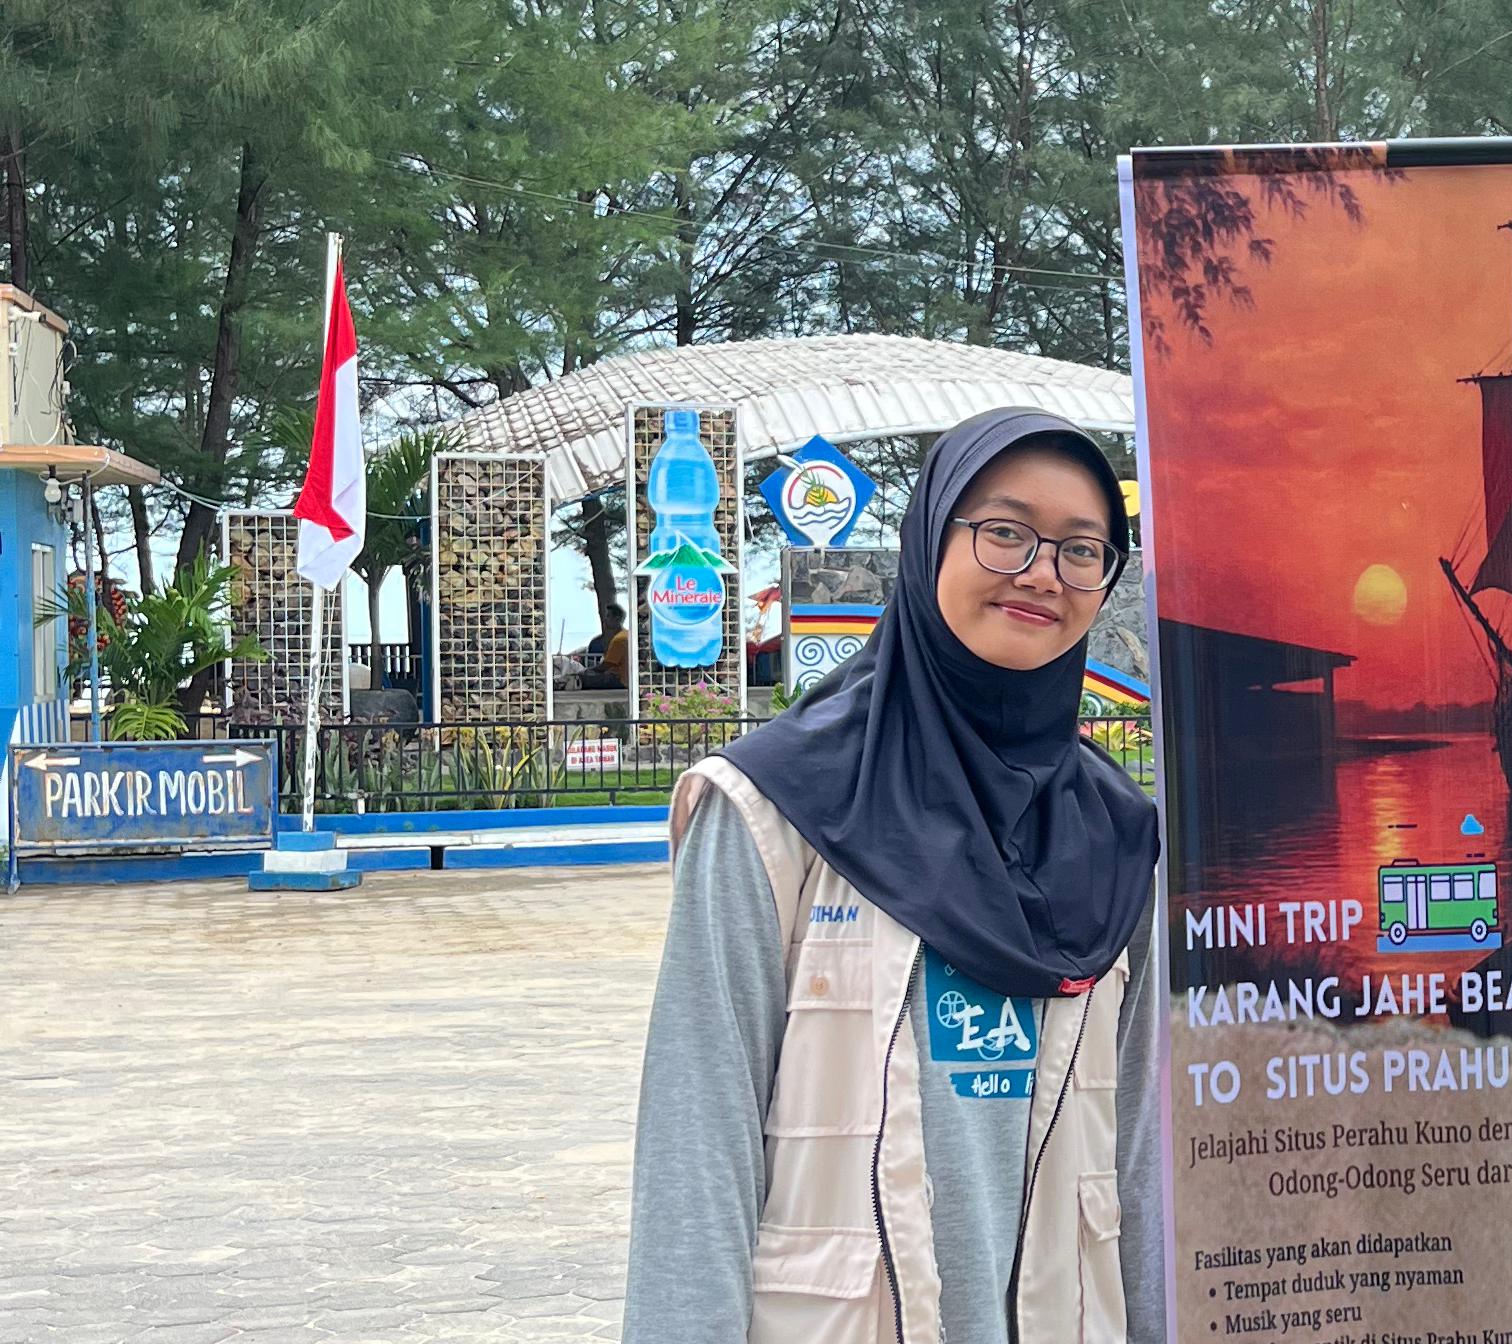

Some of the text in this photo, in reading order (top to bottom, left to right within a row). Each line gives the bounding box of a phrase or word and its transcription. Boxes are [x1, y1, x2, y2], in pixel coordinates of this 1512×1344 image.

[653, 589, 721, 603] Minerale
[676, 576, 696, 591] Le
[44, 770, 254, 817] PARKIR MOBIL
[1186, 899, 1363, 951] MINI TRIP
[1187, 976, 1341, 1028] KARANG
[1355, 973, 1446, 1016] JAHE
[971, 1074, 1010, 1097] Hello
[1188, 1060, 1241, 1106] TO
[1266, 1051, 1370, 1099] SITUS
[1384, 1045, 1509, 1093] PRAHU
[1190, 1128, 1269, 1168] Jelajahi
[1274, 1127, 1326, 1154] Situs
[1332, 1120, 1408, 1148] Perahu
[1415, 1120, 1472, 1145] Kuno
[1269, 1163, 1416, 1199] Odong-Odong
[1421, 1162, 1470, 1187] Seru
[1194, 1232, 1452, 1270] Fasilitas yang akan didapatkan
[1224, 1268, 1464, 1302] Tempat duduk yang nyaman
[1225, 1305, 1363, 1334] Musik yang seru
